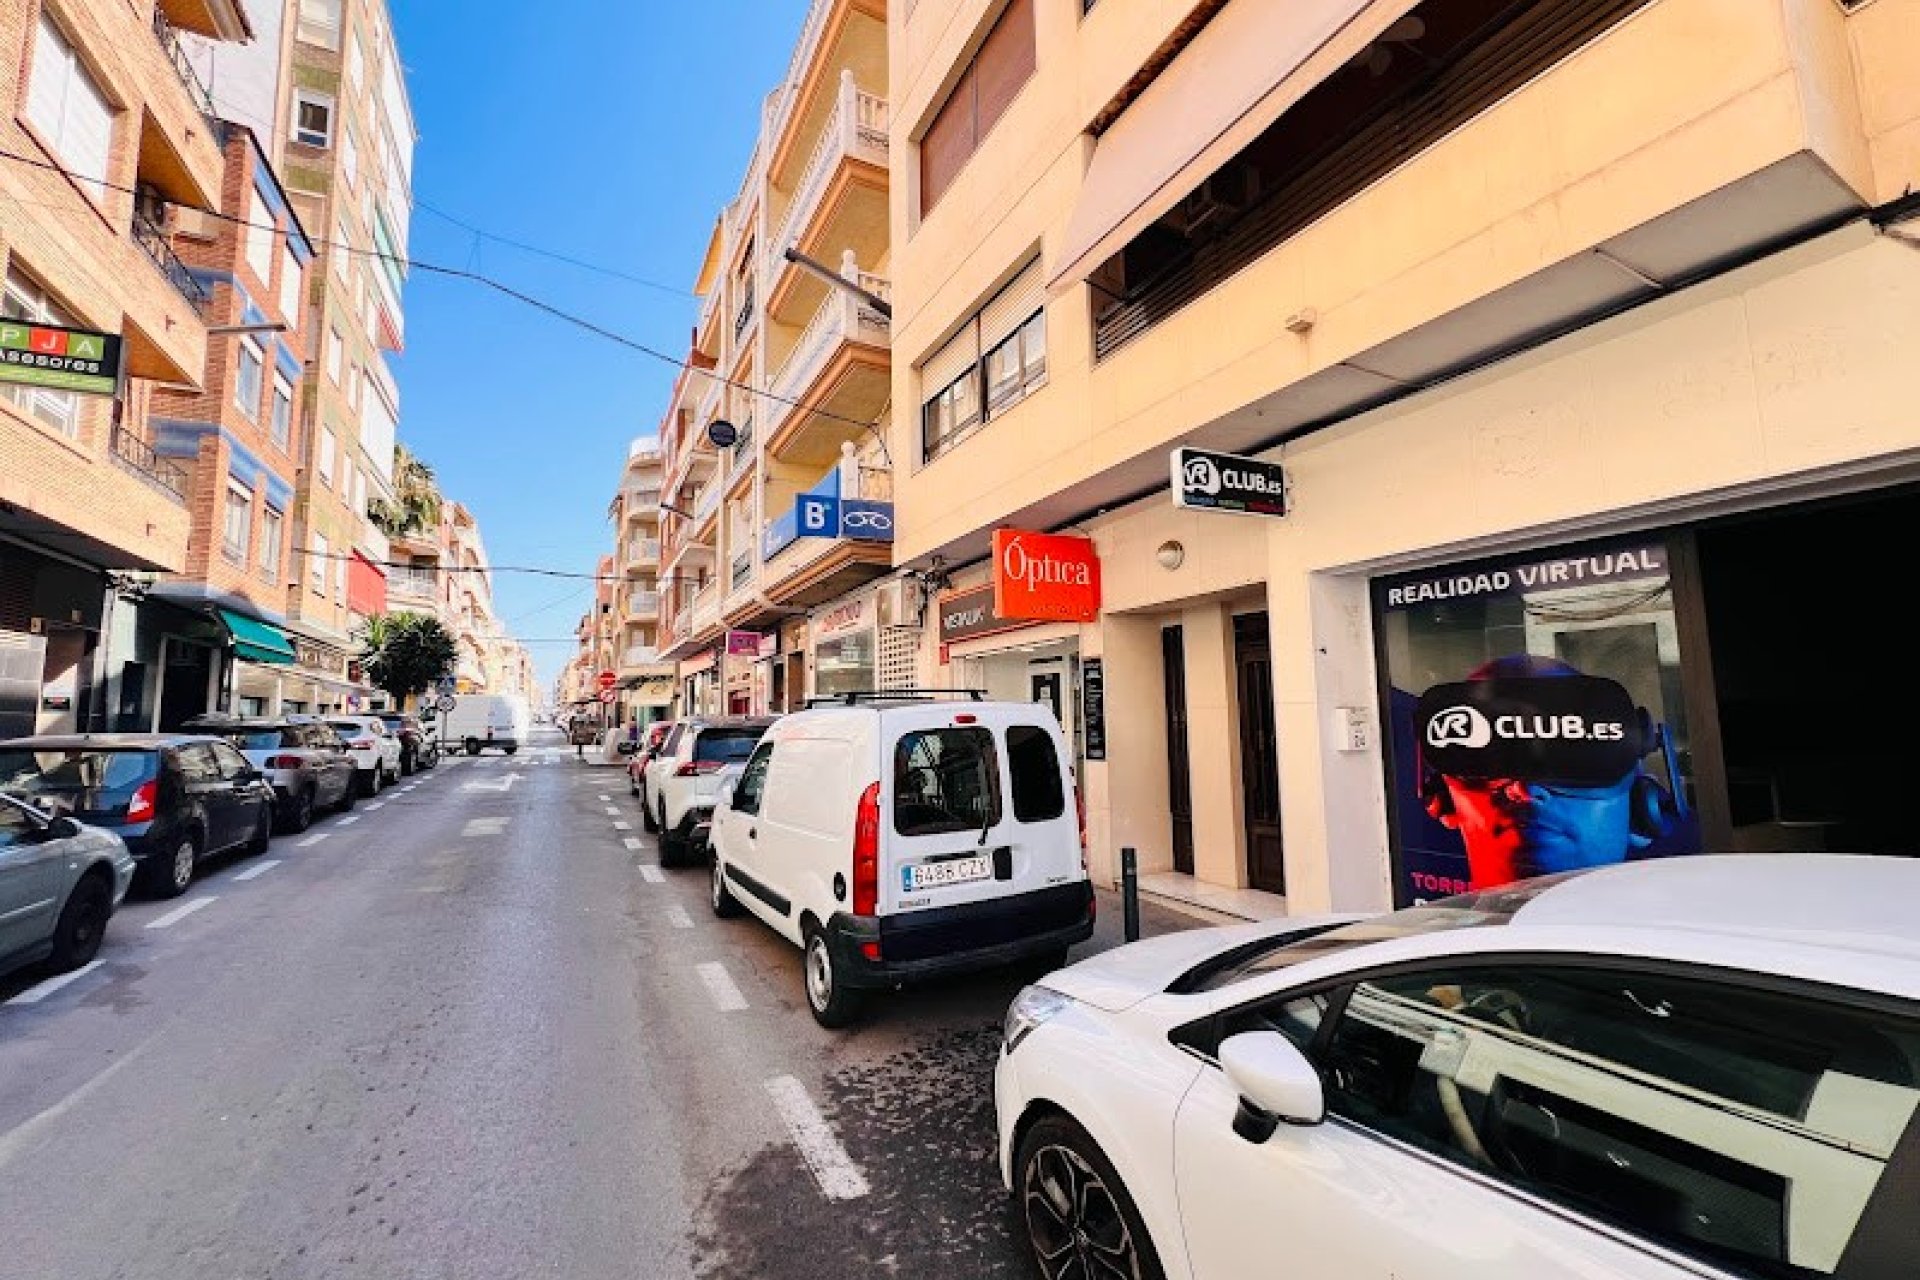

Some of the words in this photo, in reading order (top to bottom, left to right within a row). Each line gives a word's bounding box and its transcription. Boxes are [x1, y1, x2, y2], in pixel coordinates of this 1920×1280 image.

[1003, 535, 1092, 592] Óptica
[1388, 571, 1511, 607] REALIDAD
[1516, 548, 1661, 587] VIRTUAL
